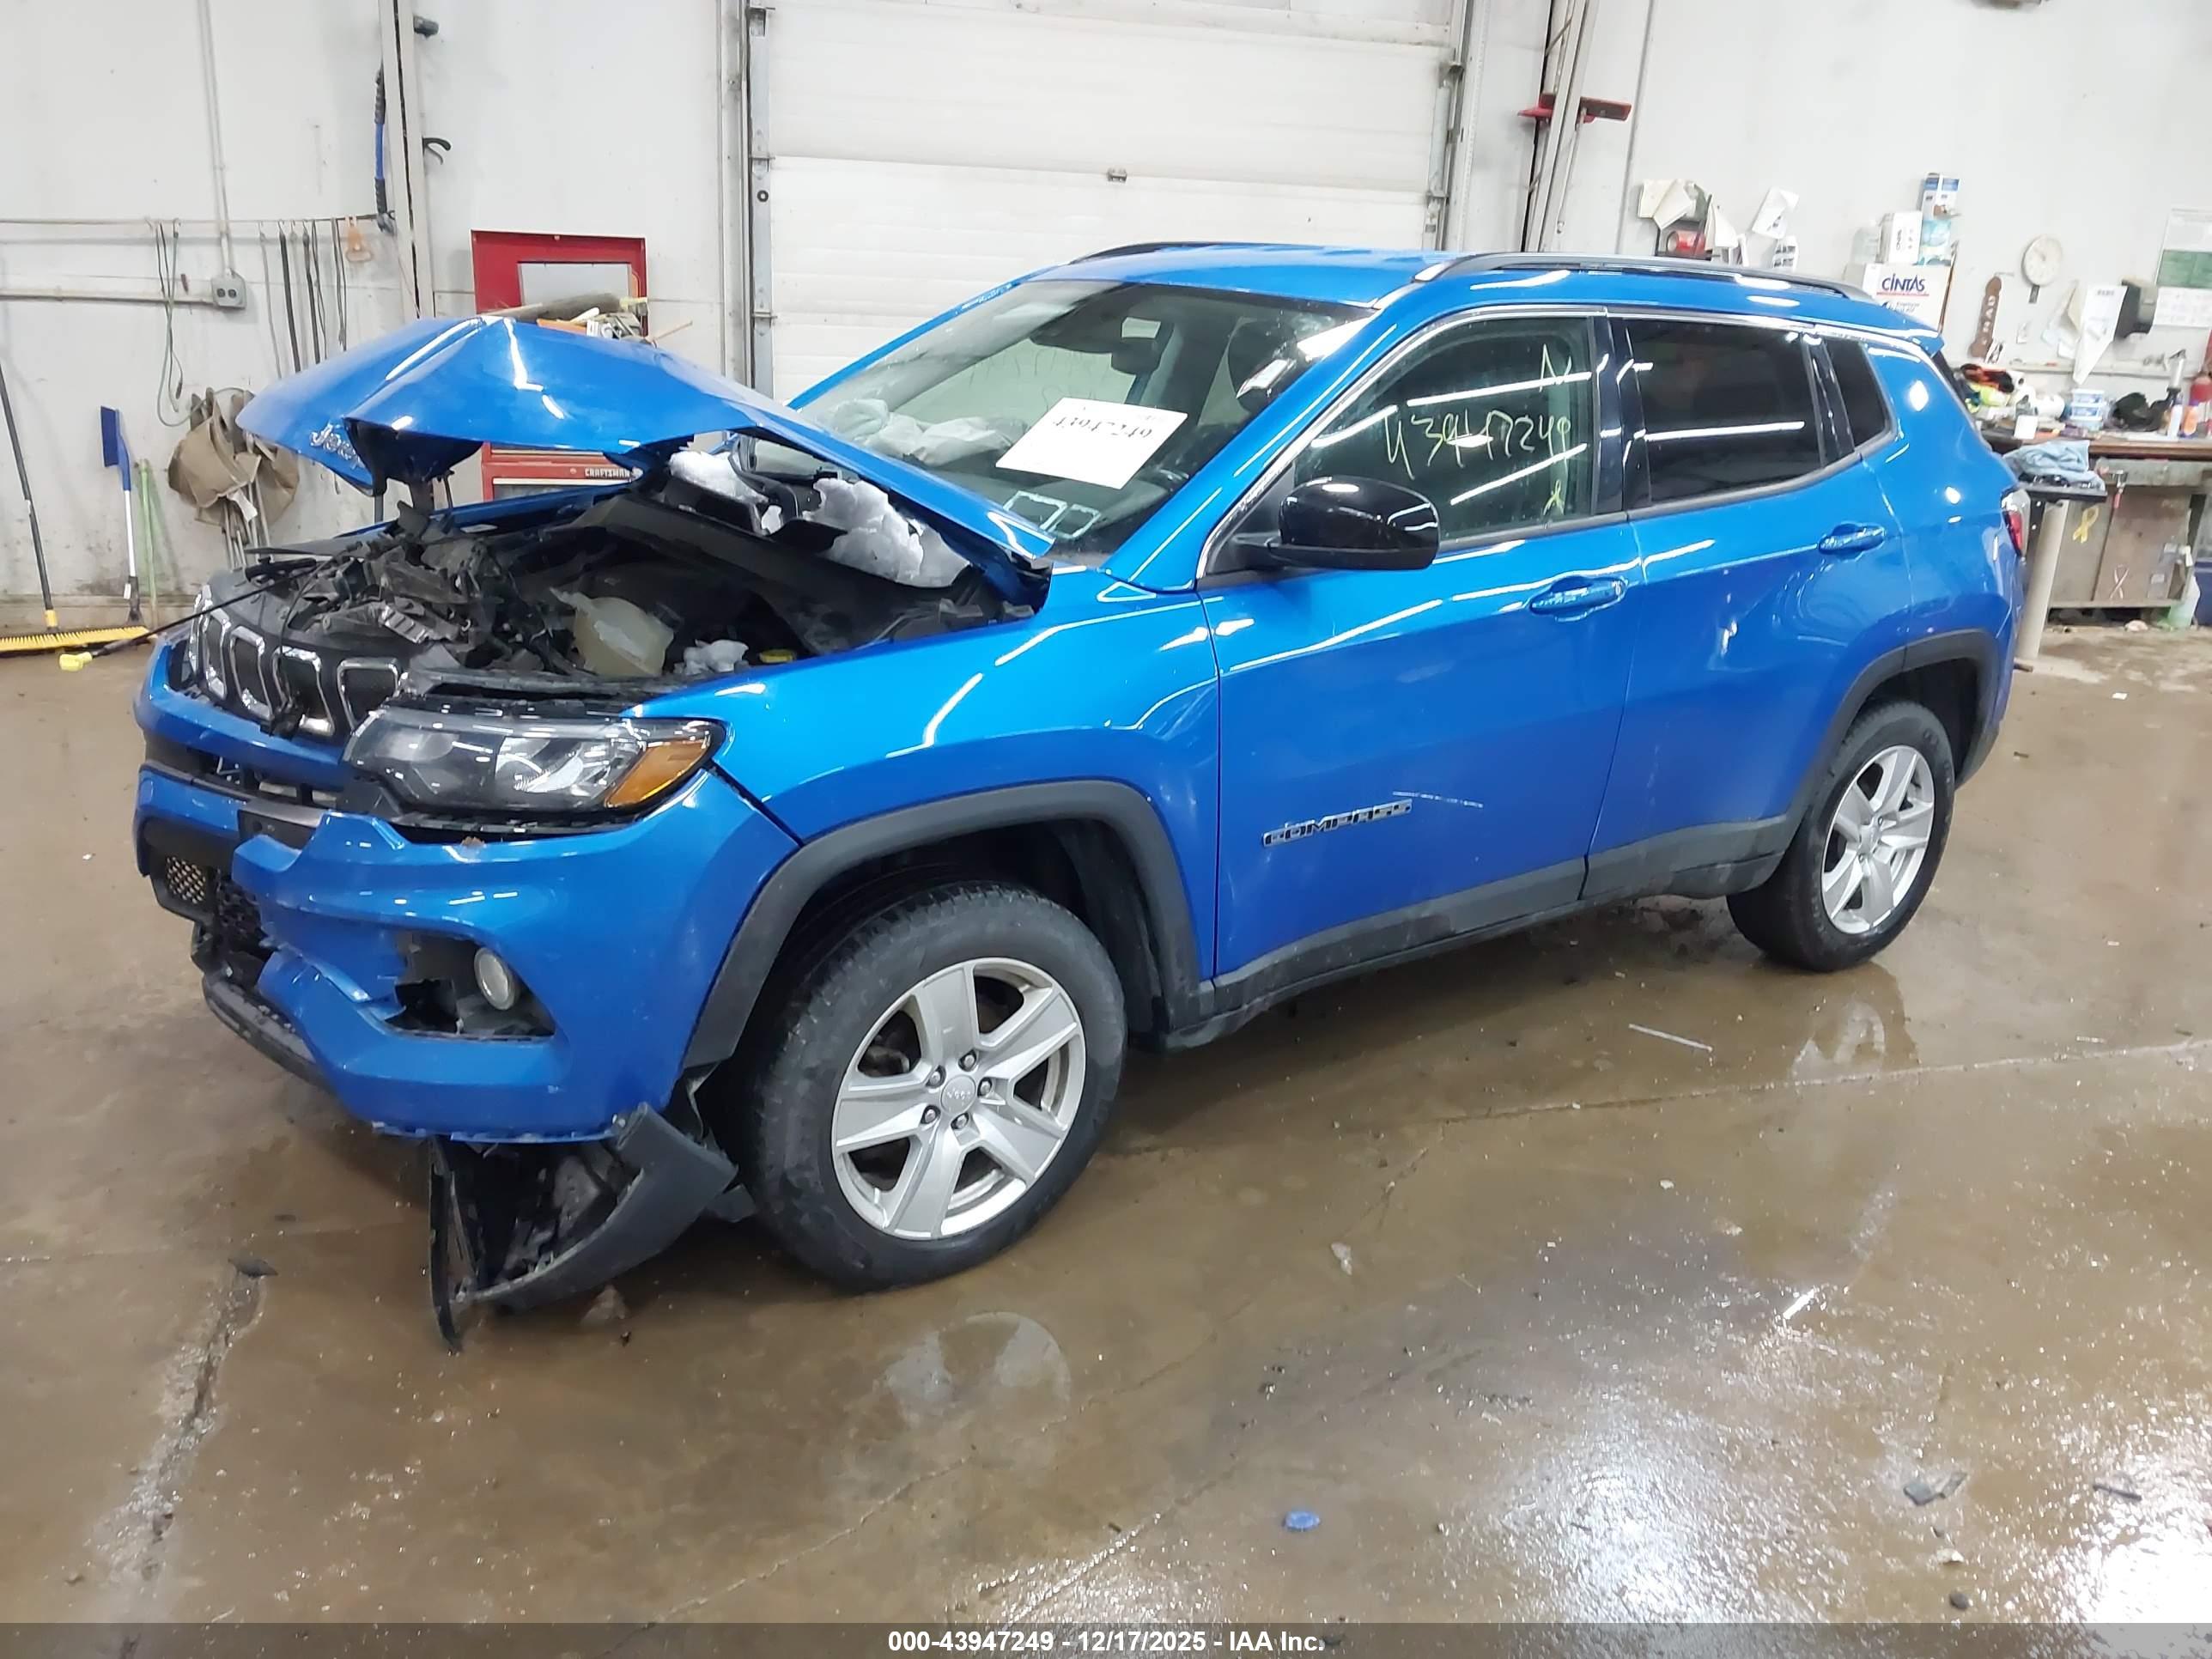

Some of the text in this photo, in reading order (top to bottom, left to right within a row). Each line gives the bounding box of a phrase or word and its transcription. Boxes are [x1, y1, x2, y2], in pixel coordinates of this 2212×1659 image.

[1881, 272, 1925, 291] CINTAS
[585, 468, 631, 478] CRAFTSMAN
[1262, 799, 1413, 848] COMPASS
